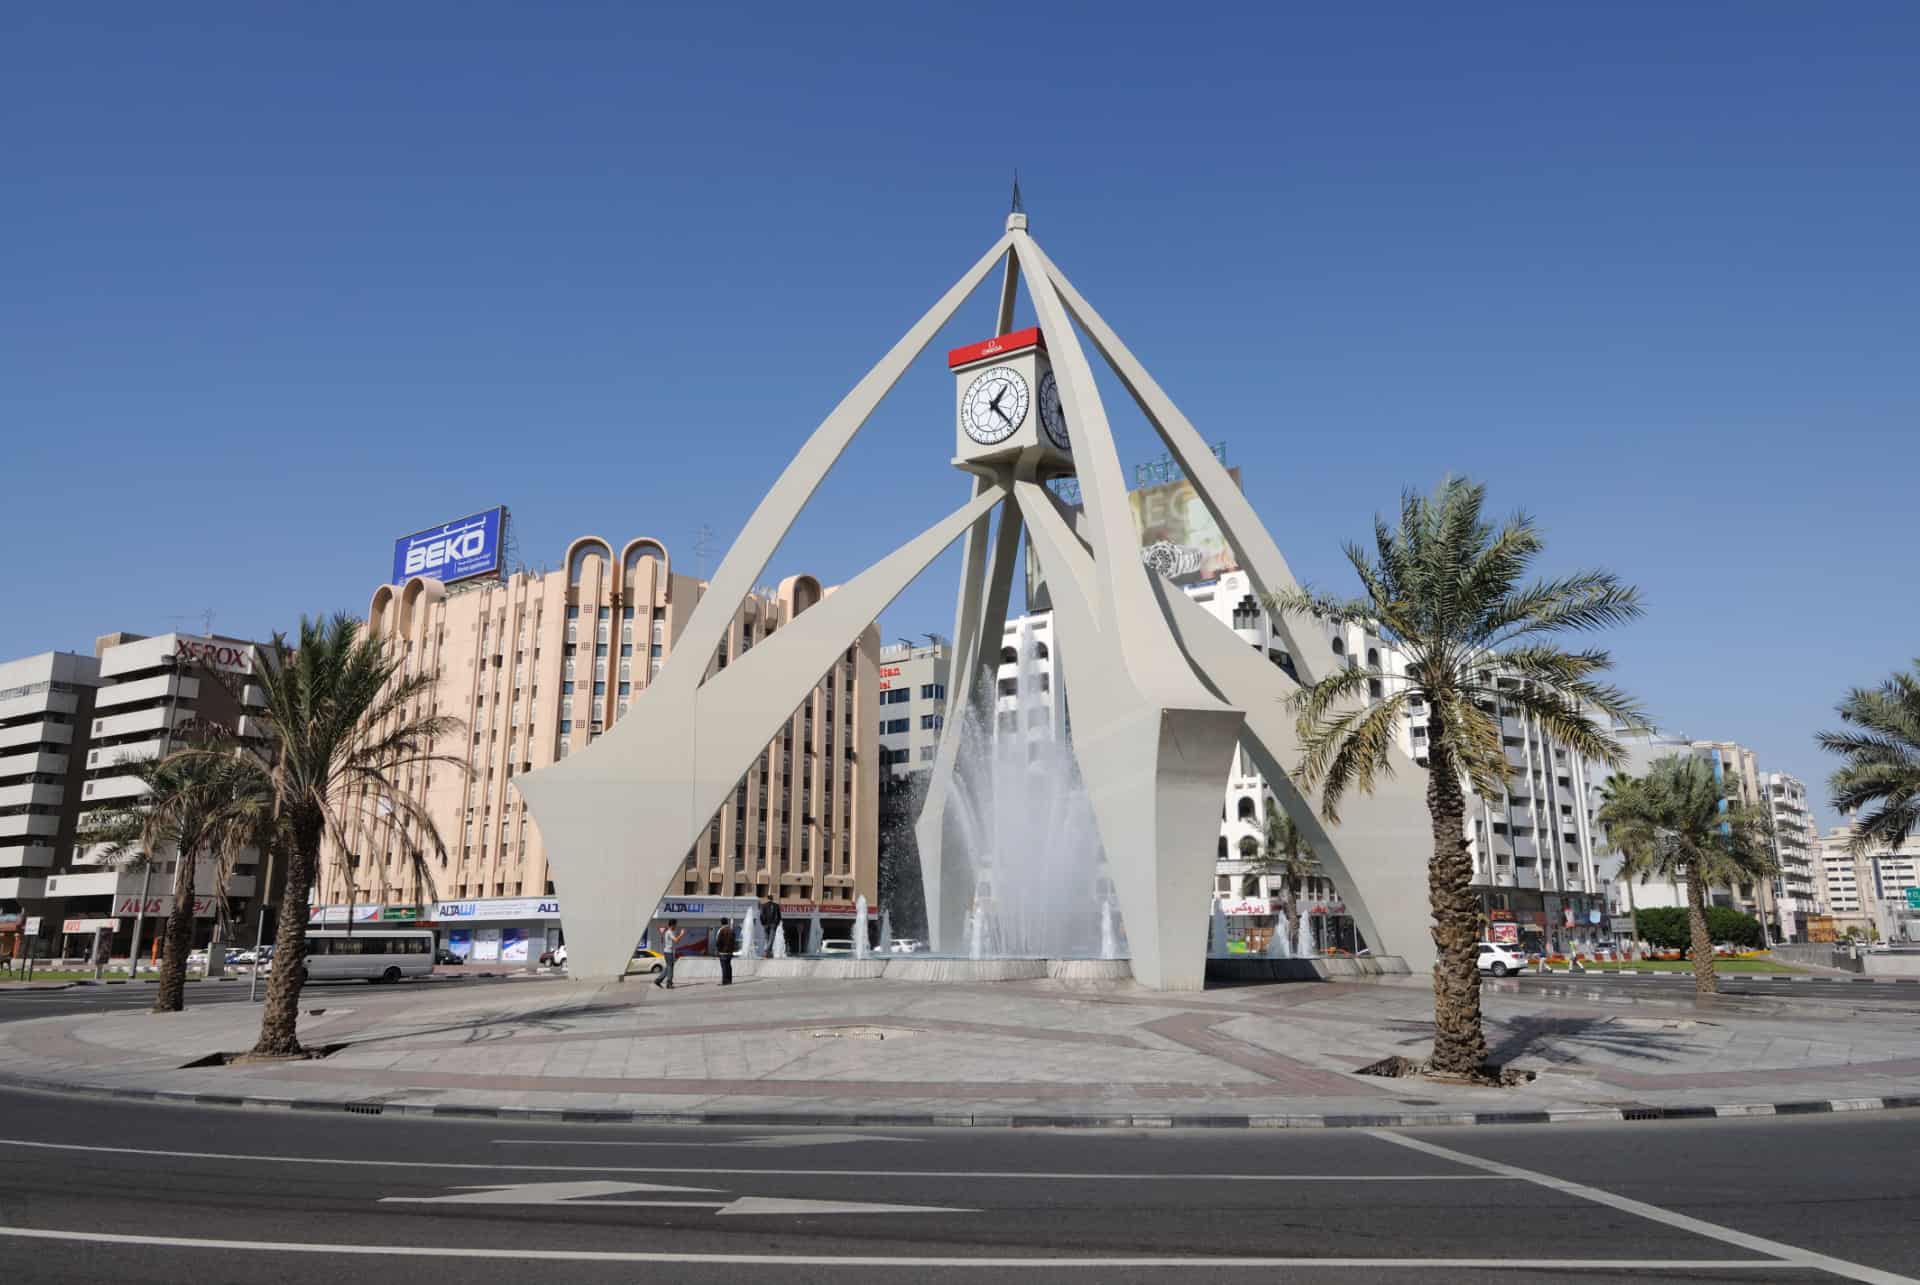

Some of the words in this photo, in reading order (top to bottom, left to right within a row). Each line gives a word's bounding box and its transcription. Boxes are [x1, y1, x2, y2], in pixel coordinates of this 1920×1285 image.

[404, 529, 485, 575] BEKO
[176, 640, 246, 668] XEROX
[537, 903, 560, 913] ALT
[664, 903, 687, 913] ALTA
